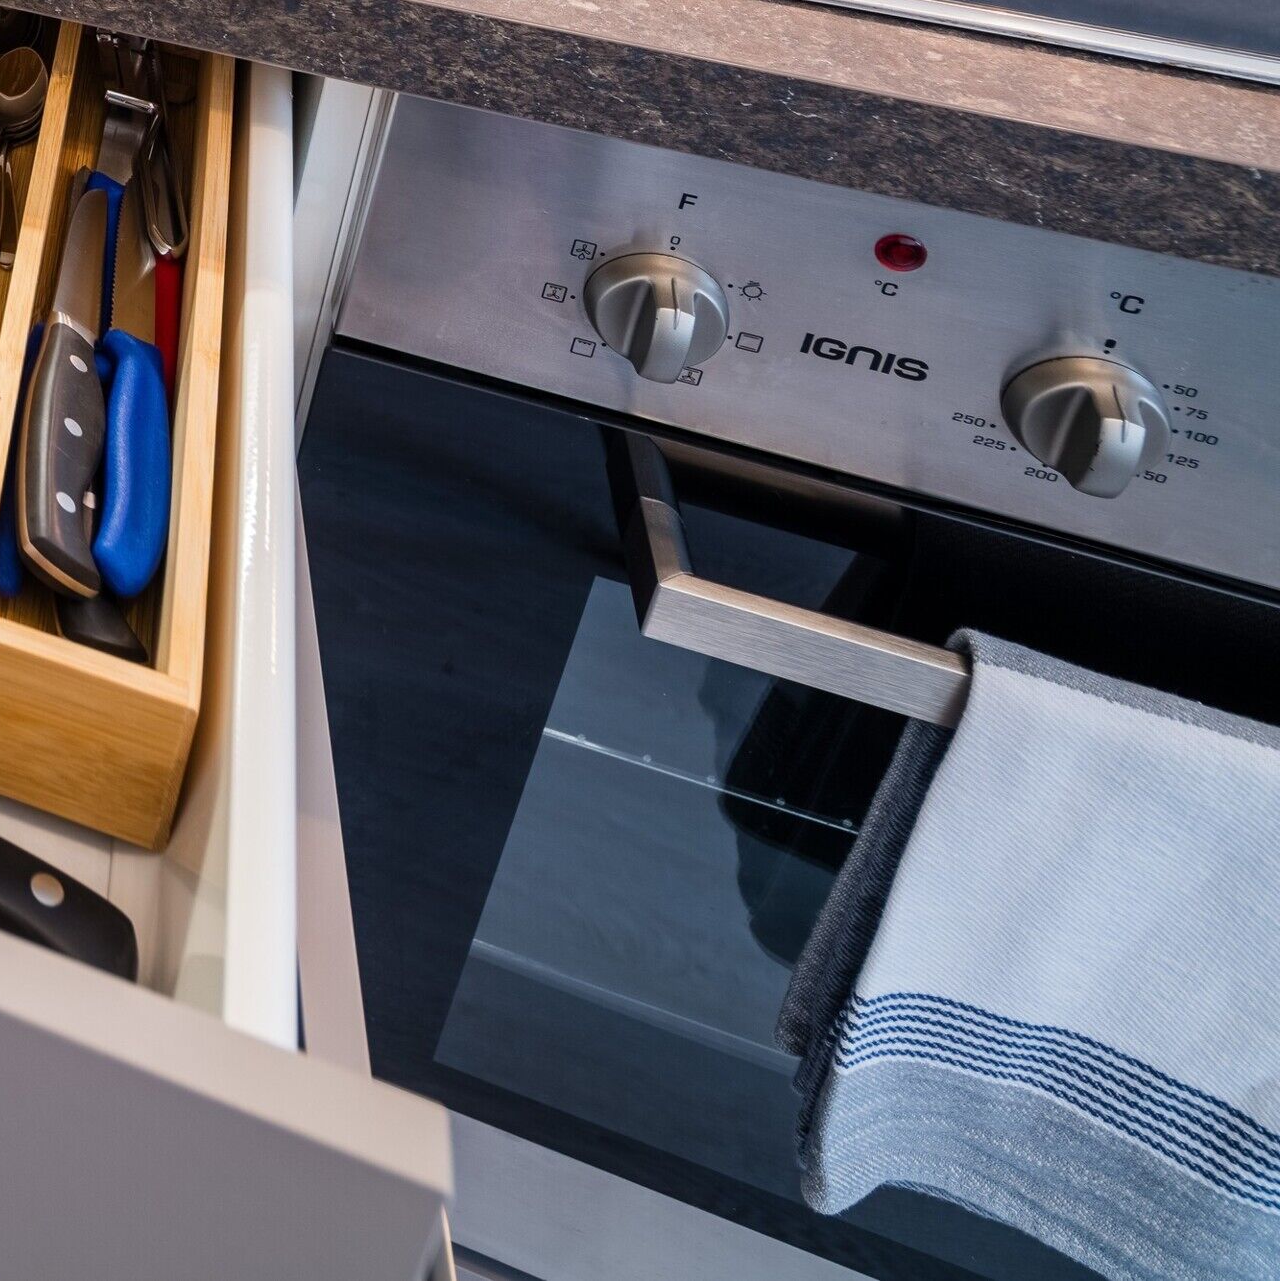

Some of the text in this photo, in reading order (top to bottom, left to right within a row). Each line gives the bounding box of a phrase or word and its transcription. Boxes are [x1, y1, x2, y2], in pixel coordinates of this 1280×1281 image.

[678, 193, 698, 210] F
[874, 280, 899, 297] °C
[1110, 291, 1145, 315] °C
[799, 332, 930, 382] IGNIS
[1173, 384, 1199, 399] 50
[951, 412, 986, 428] 250
[1186, 407, 1209, 421] 75
[972, 434, 1006, 452] 225
[1183, 429, 1219, 447] 100
[1166, 453, 1200, 469] 125
[1023, 466, 1059, 484] 200
